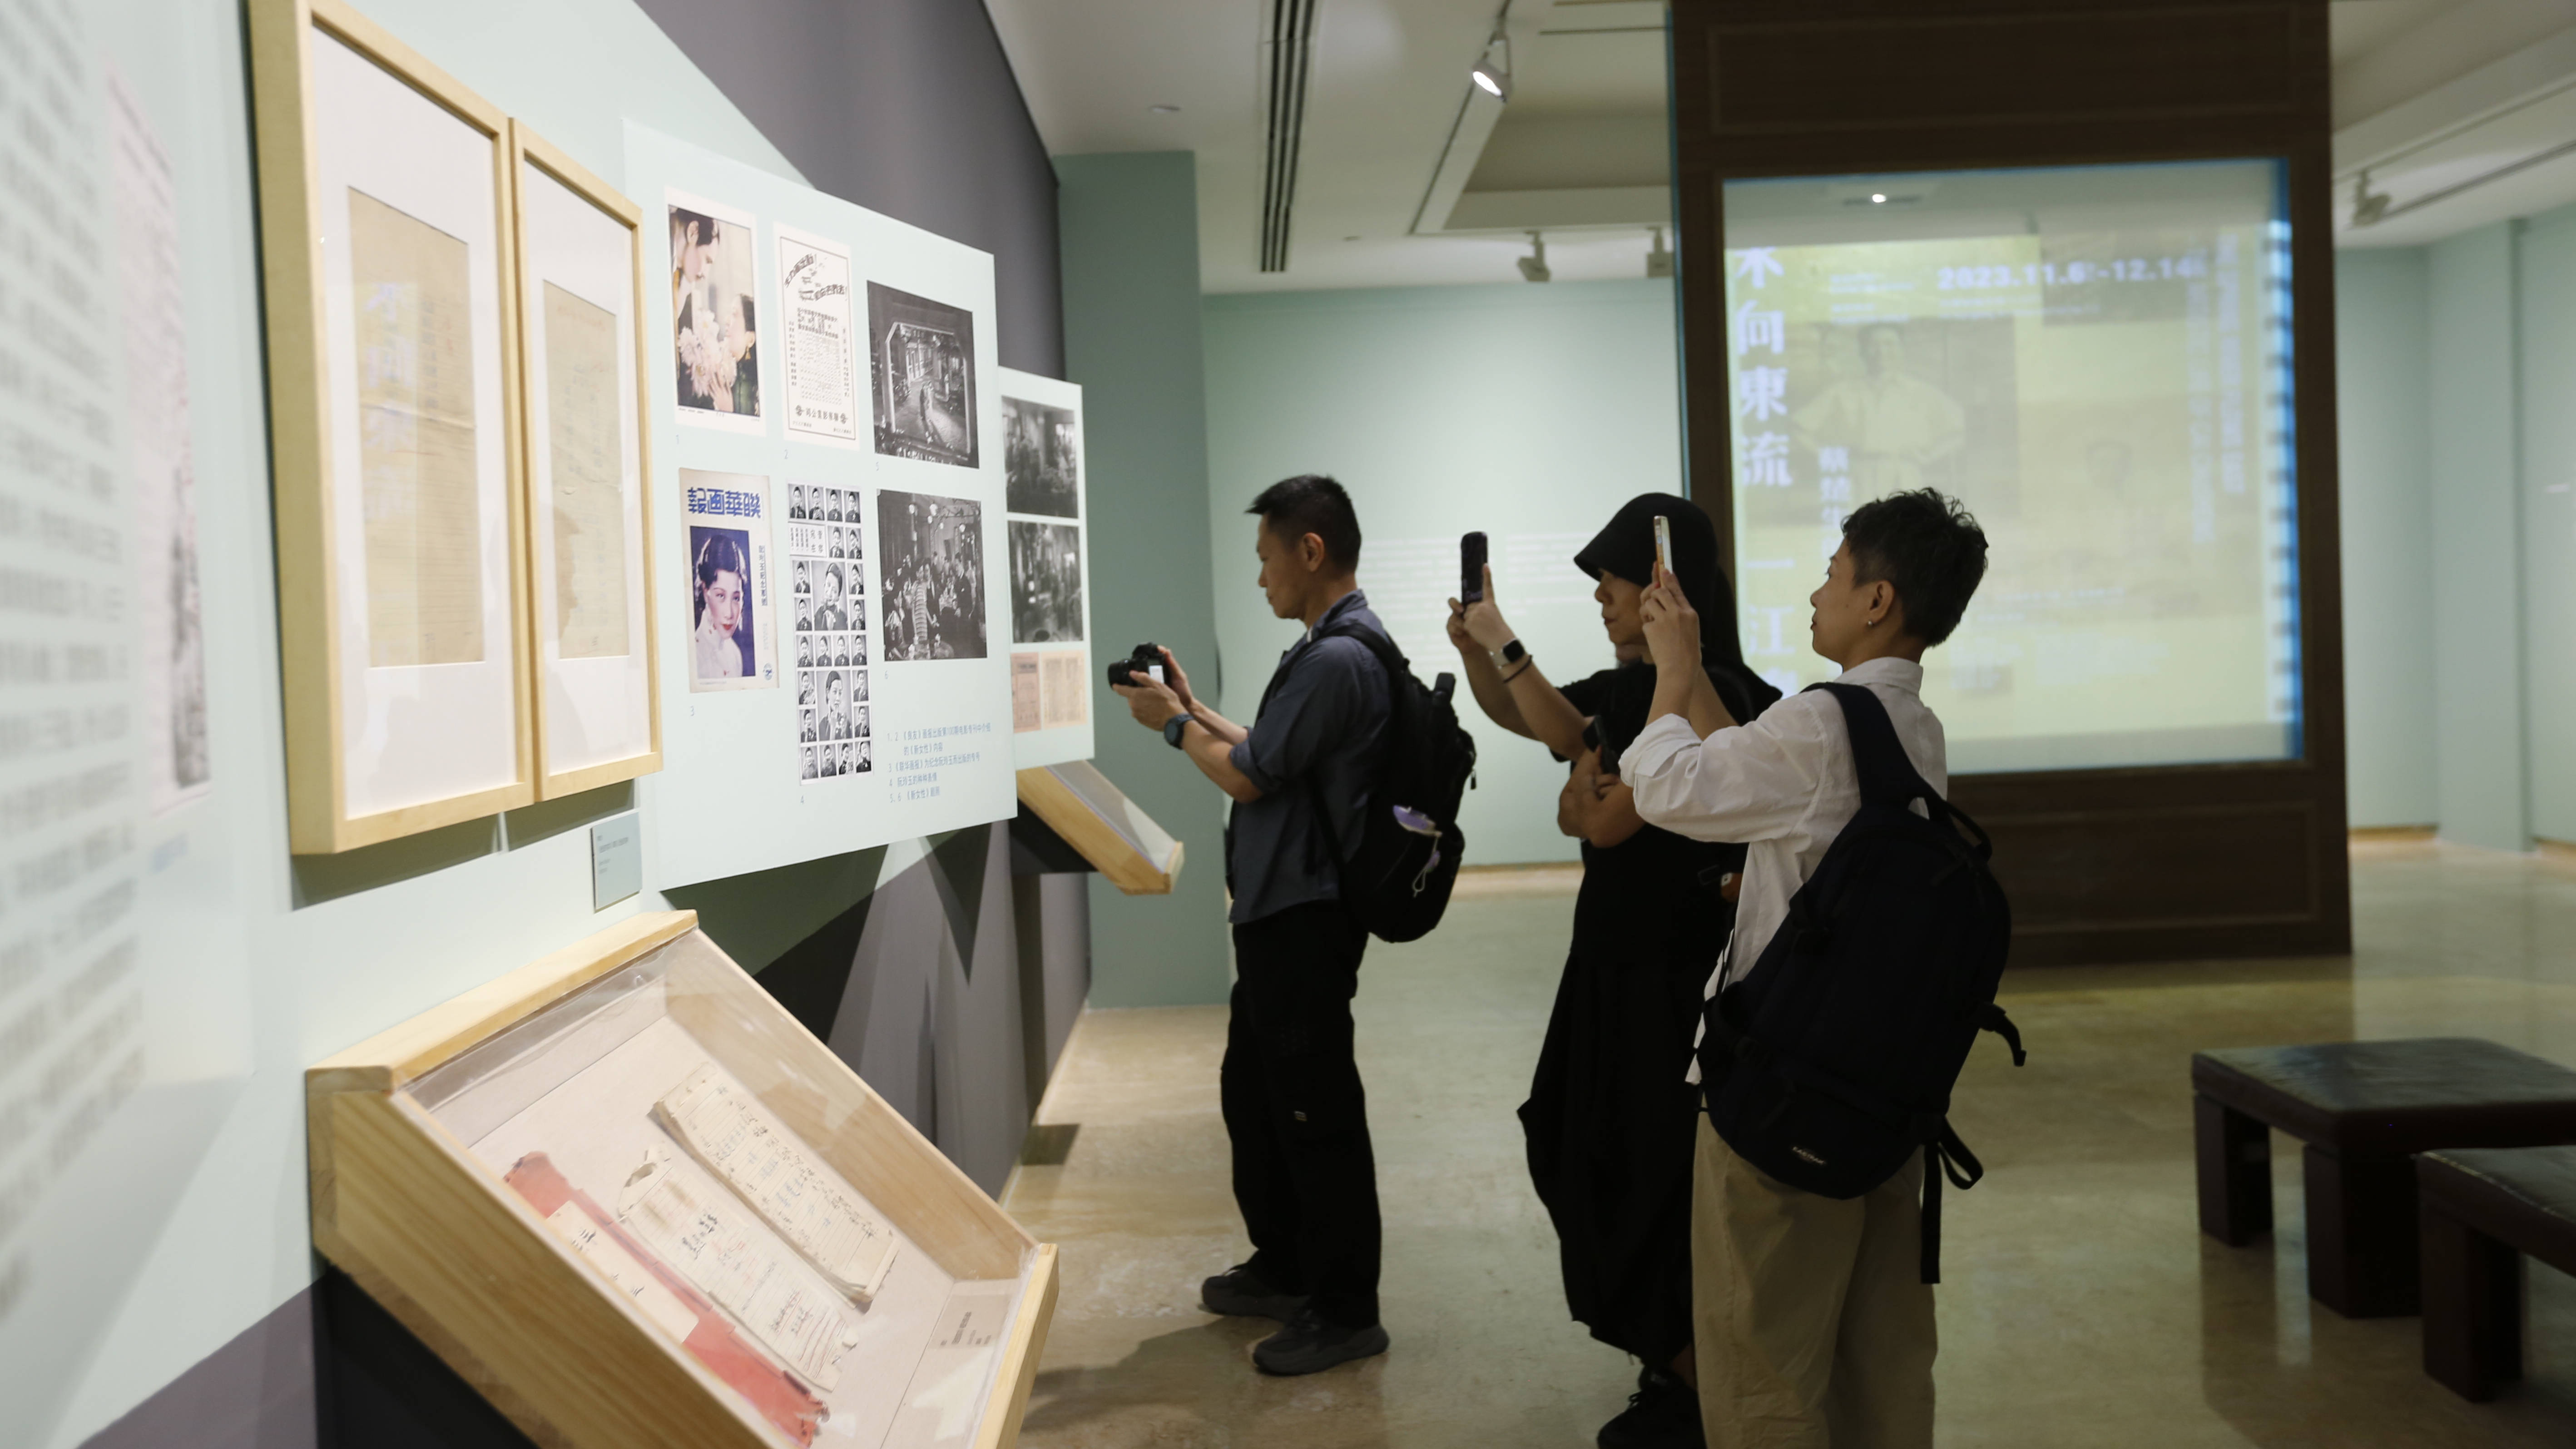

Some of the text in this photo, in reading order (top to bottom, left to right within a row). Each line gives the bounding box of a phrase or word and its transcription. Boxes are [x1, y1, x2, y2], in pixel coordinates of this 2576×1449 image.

[784, 449, 789, 459] 2
[690, 706, 695, 716] 3
[800, 795, 805, 805] 4
